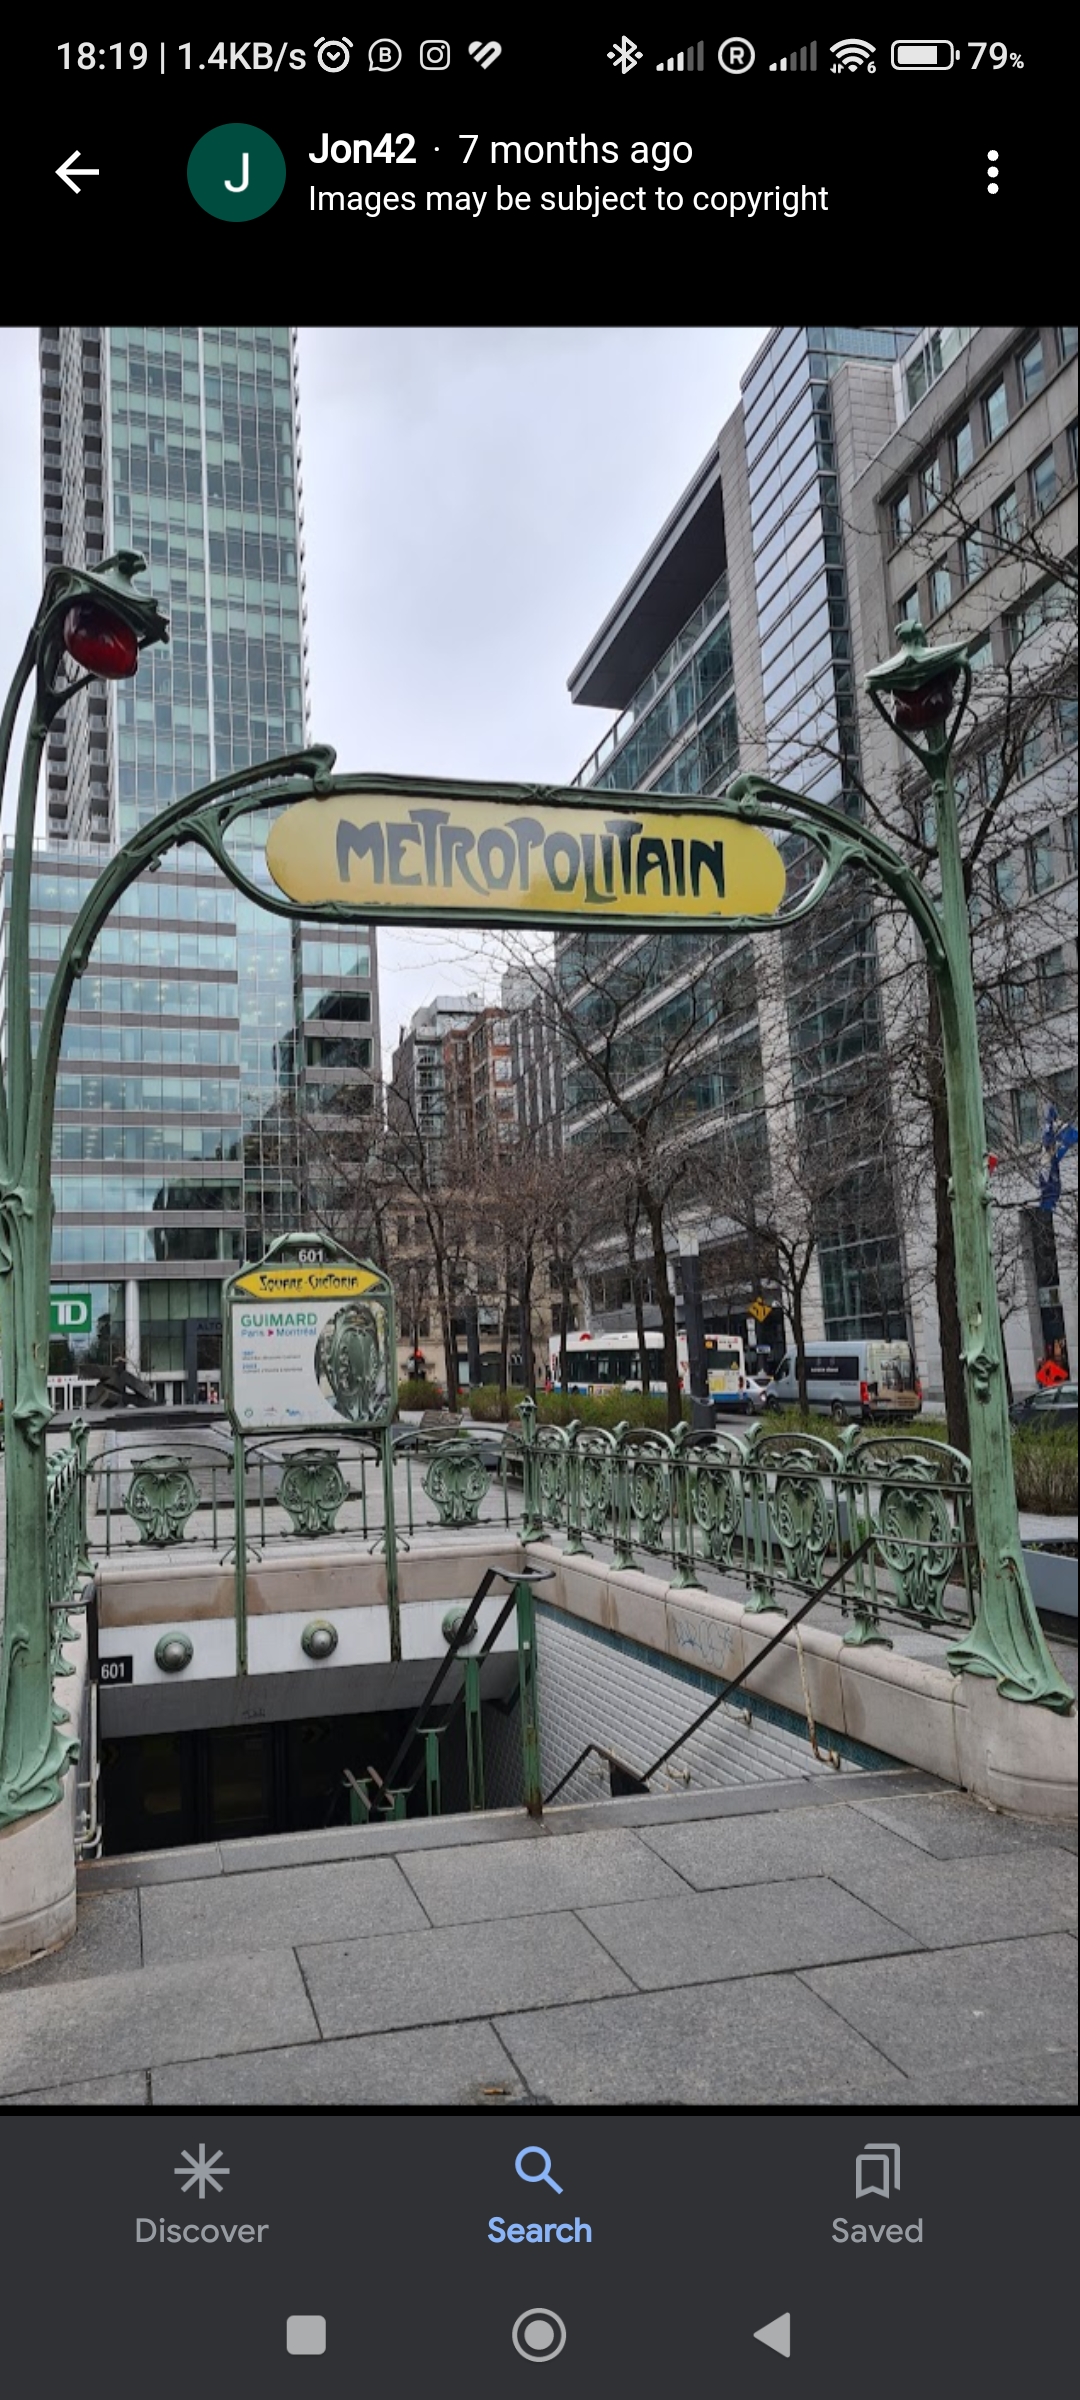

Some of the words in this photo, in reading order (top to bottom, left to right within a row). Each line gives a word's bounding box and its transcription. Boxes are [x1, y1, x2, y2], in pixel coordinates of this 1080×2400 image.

[58, 42, 148, 70] 18:19
[179, 41, 307, 73] 1.4KB/s
[967, 41, 1025, 70] 79%
[308, 132, 417, 164] Jon42
[458, 134, 479, 164] 7
[491, 132, 619, 164] months
[630, 141, 693, 172] ago
[225, 152, 250, 193] J
[310, 185, 416, 218] Images
[426, 191, 488, 218] may
[496, 184, 532, 211] be
[540, 184, 647, 218] subject
[654, 186, 684, 211] to
[692, 184, 829, 218] copyright
[335, 808, 726, 904] METROPOLITAIN
[298, 1249, 324, 1262] 601
[50, 1300, 88, 1325] TD
[240, 1312, 318, 1328] GUIMARD
[241, 1329, 265, 1337] Paris
[276, 1327, 317, 1337] Montréal
[101, 1662, 125, 1679] 601
[135, 2217, 270, 2245] Discover
[487, 2216, 592, 2245] Search
[831, 2217, 924, 2245] Saved
